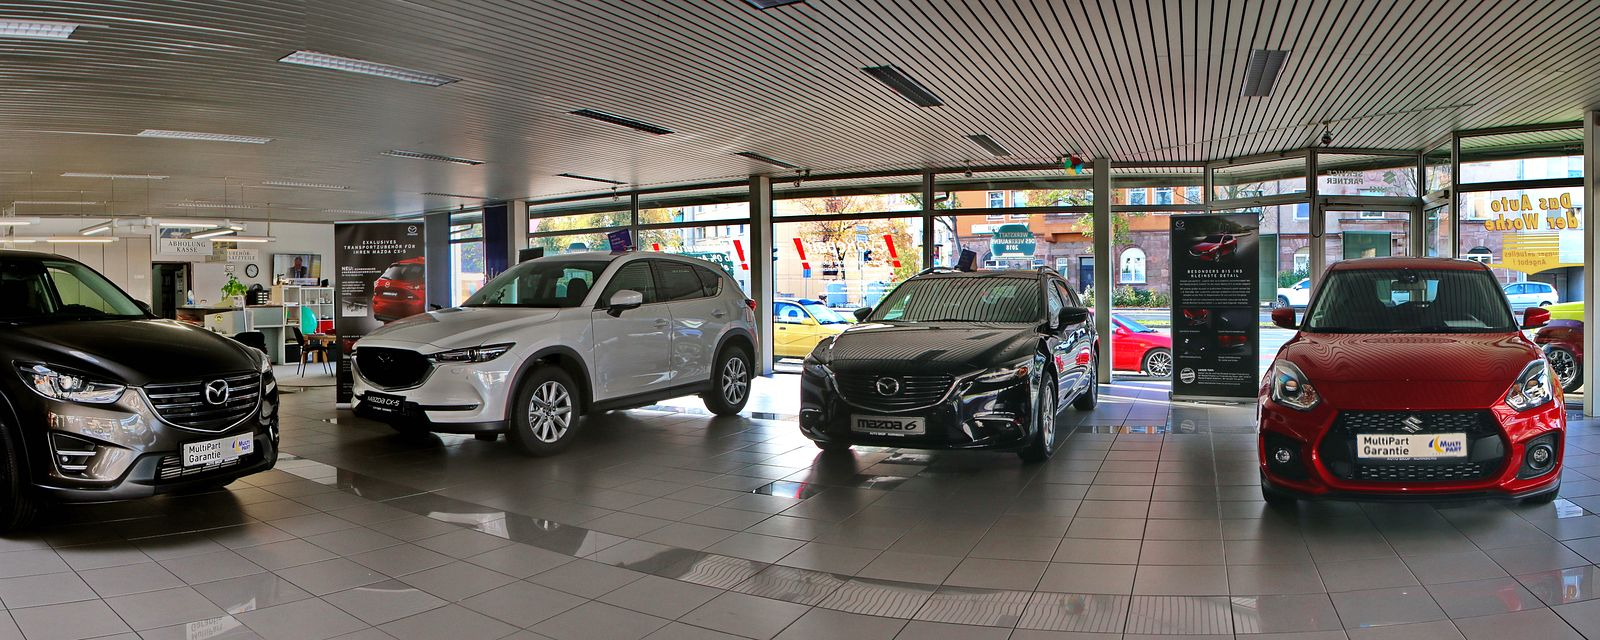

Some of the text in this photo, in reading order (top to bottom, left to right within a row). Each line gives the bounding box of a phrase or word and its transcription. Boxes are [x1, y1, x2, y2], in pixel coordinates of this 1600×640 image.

[904, 421, 917, 430] 6
[1364, 437, 1410, 446] MultiPart
[189, 442, 221, 453] MultiPart
[1364, 446, 1410, 455] Garantie
[189, 451, 221, 463] Garantie
